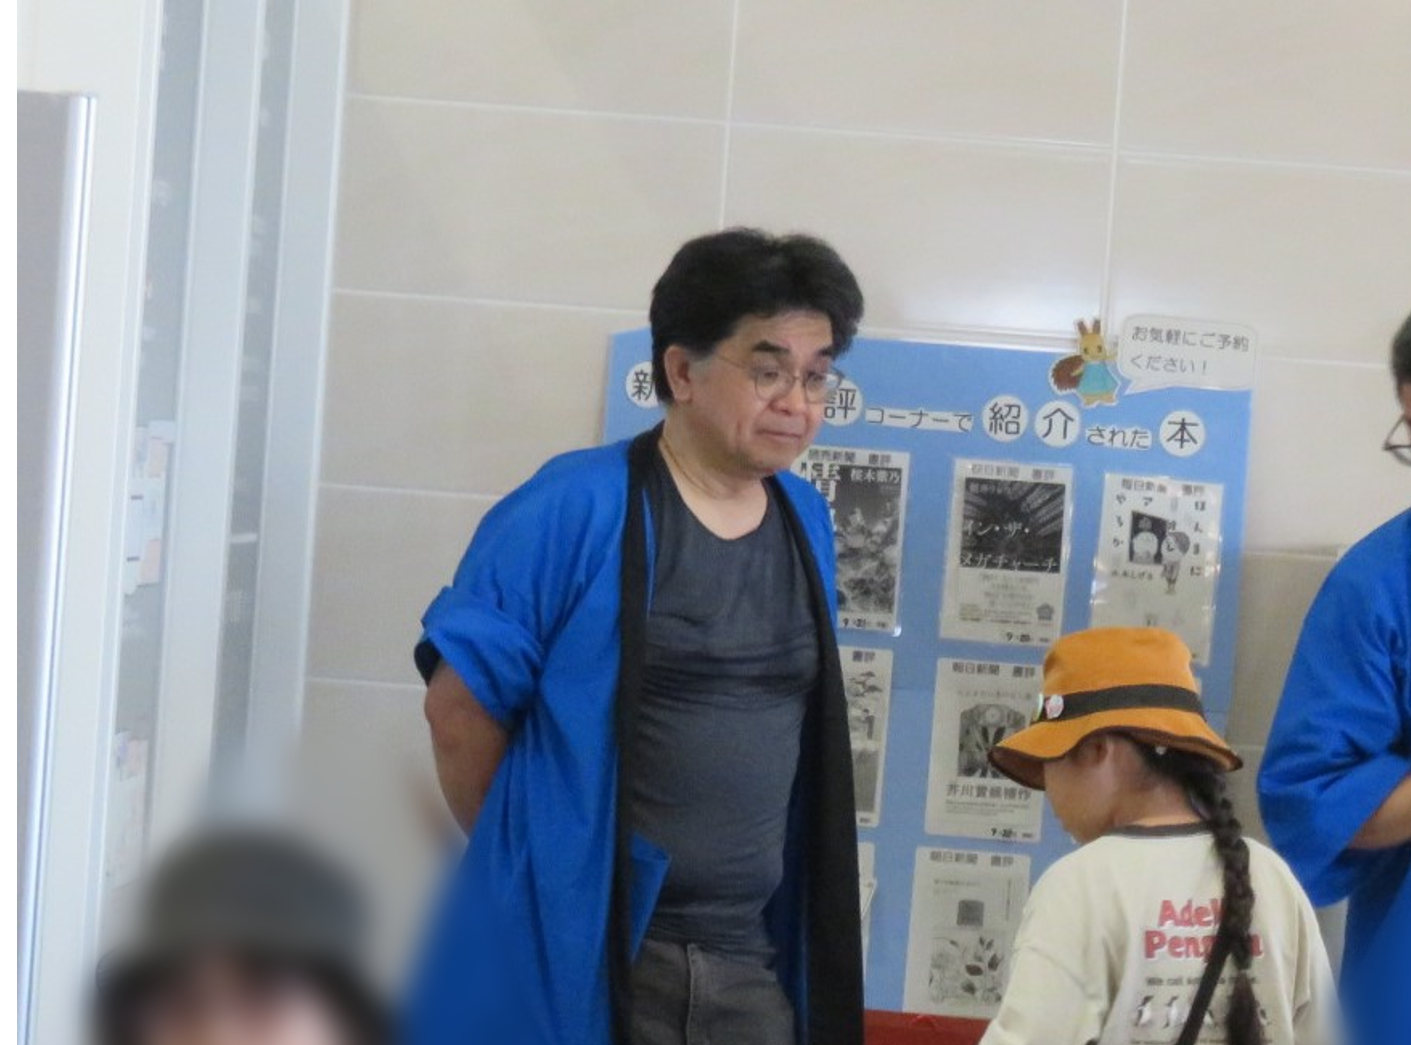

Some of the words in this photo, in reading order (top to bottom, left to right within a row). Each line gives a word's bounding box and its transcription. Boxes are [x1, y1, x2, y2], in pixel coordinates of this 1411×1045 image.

[1131, 326, 1250, 352] お気軽にご予約
